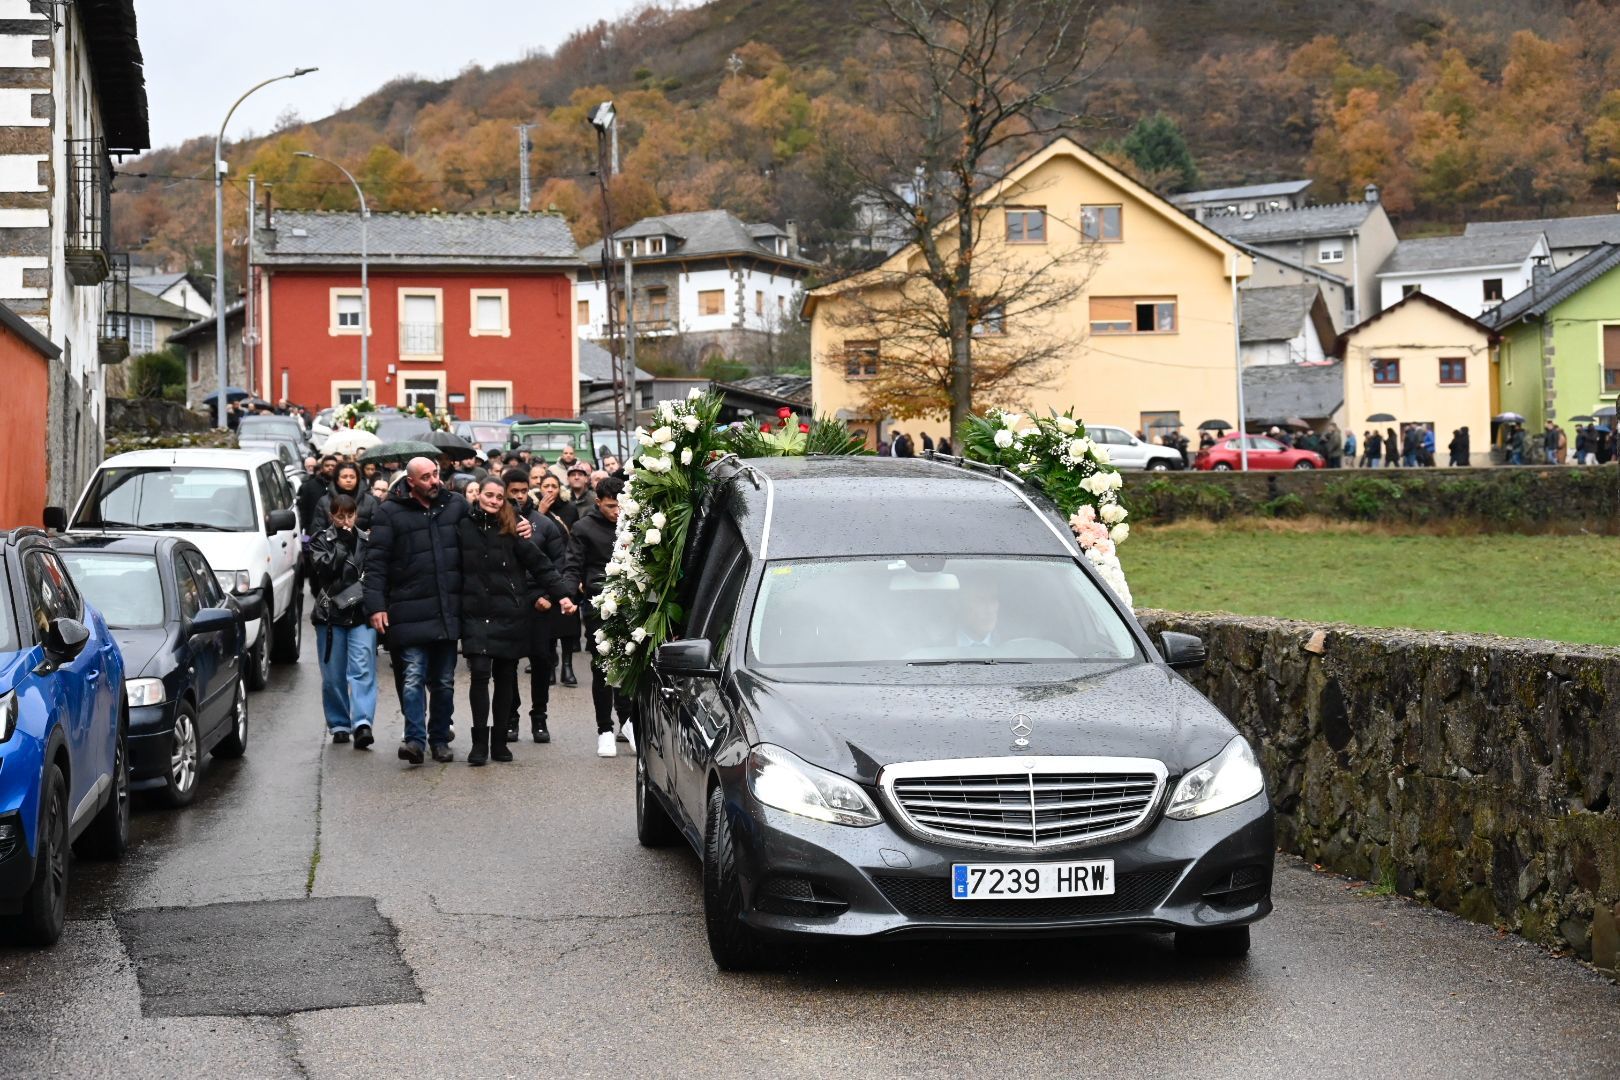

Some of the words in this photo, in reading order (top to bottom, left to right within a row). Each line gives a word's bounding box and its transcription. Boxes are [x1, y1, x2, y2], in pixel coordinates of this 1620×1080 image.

[970, 868, 1040, 894] 7239
[1057, 865, 1106, 893] HRW
[957, 885, 965, 893] E
